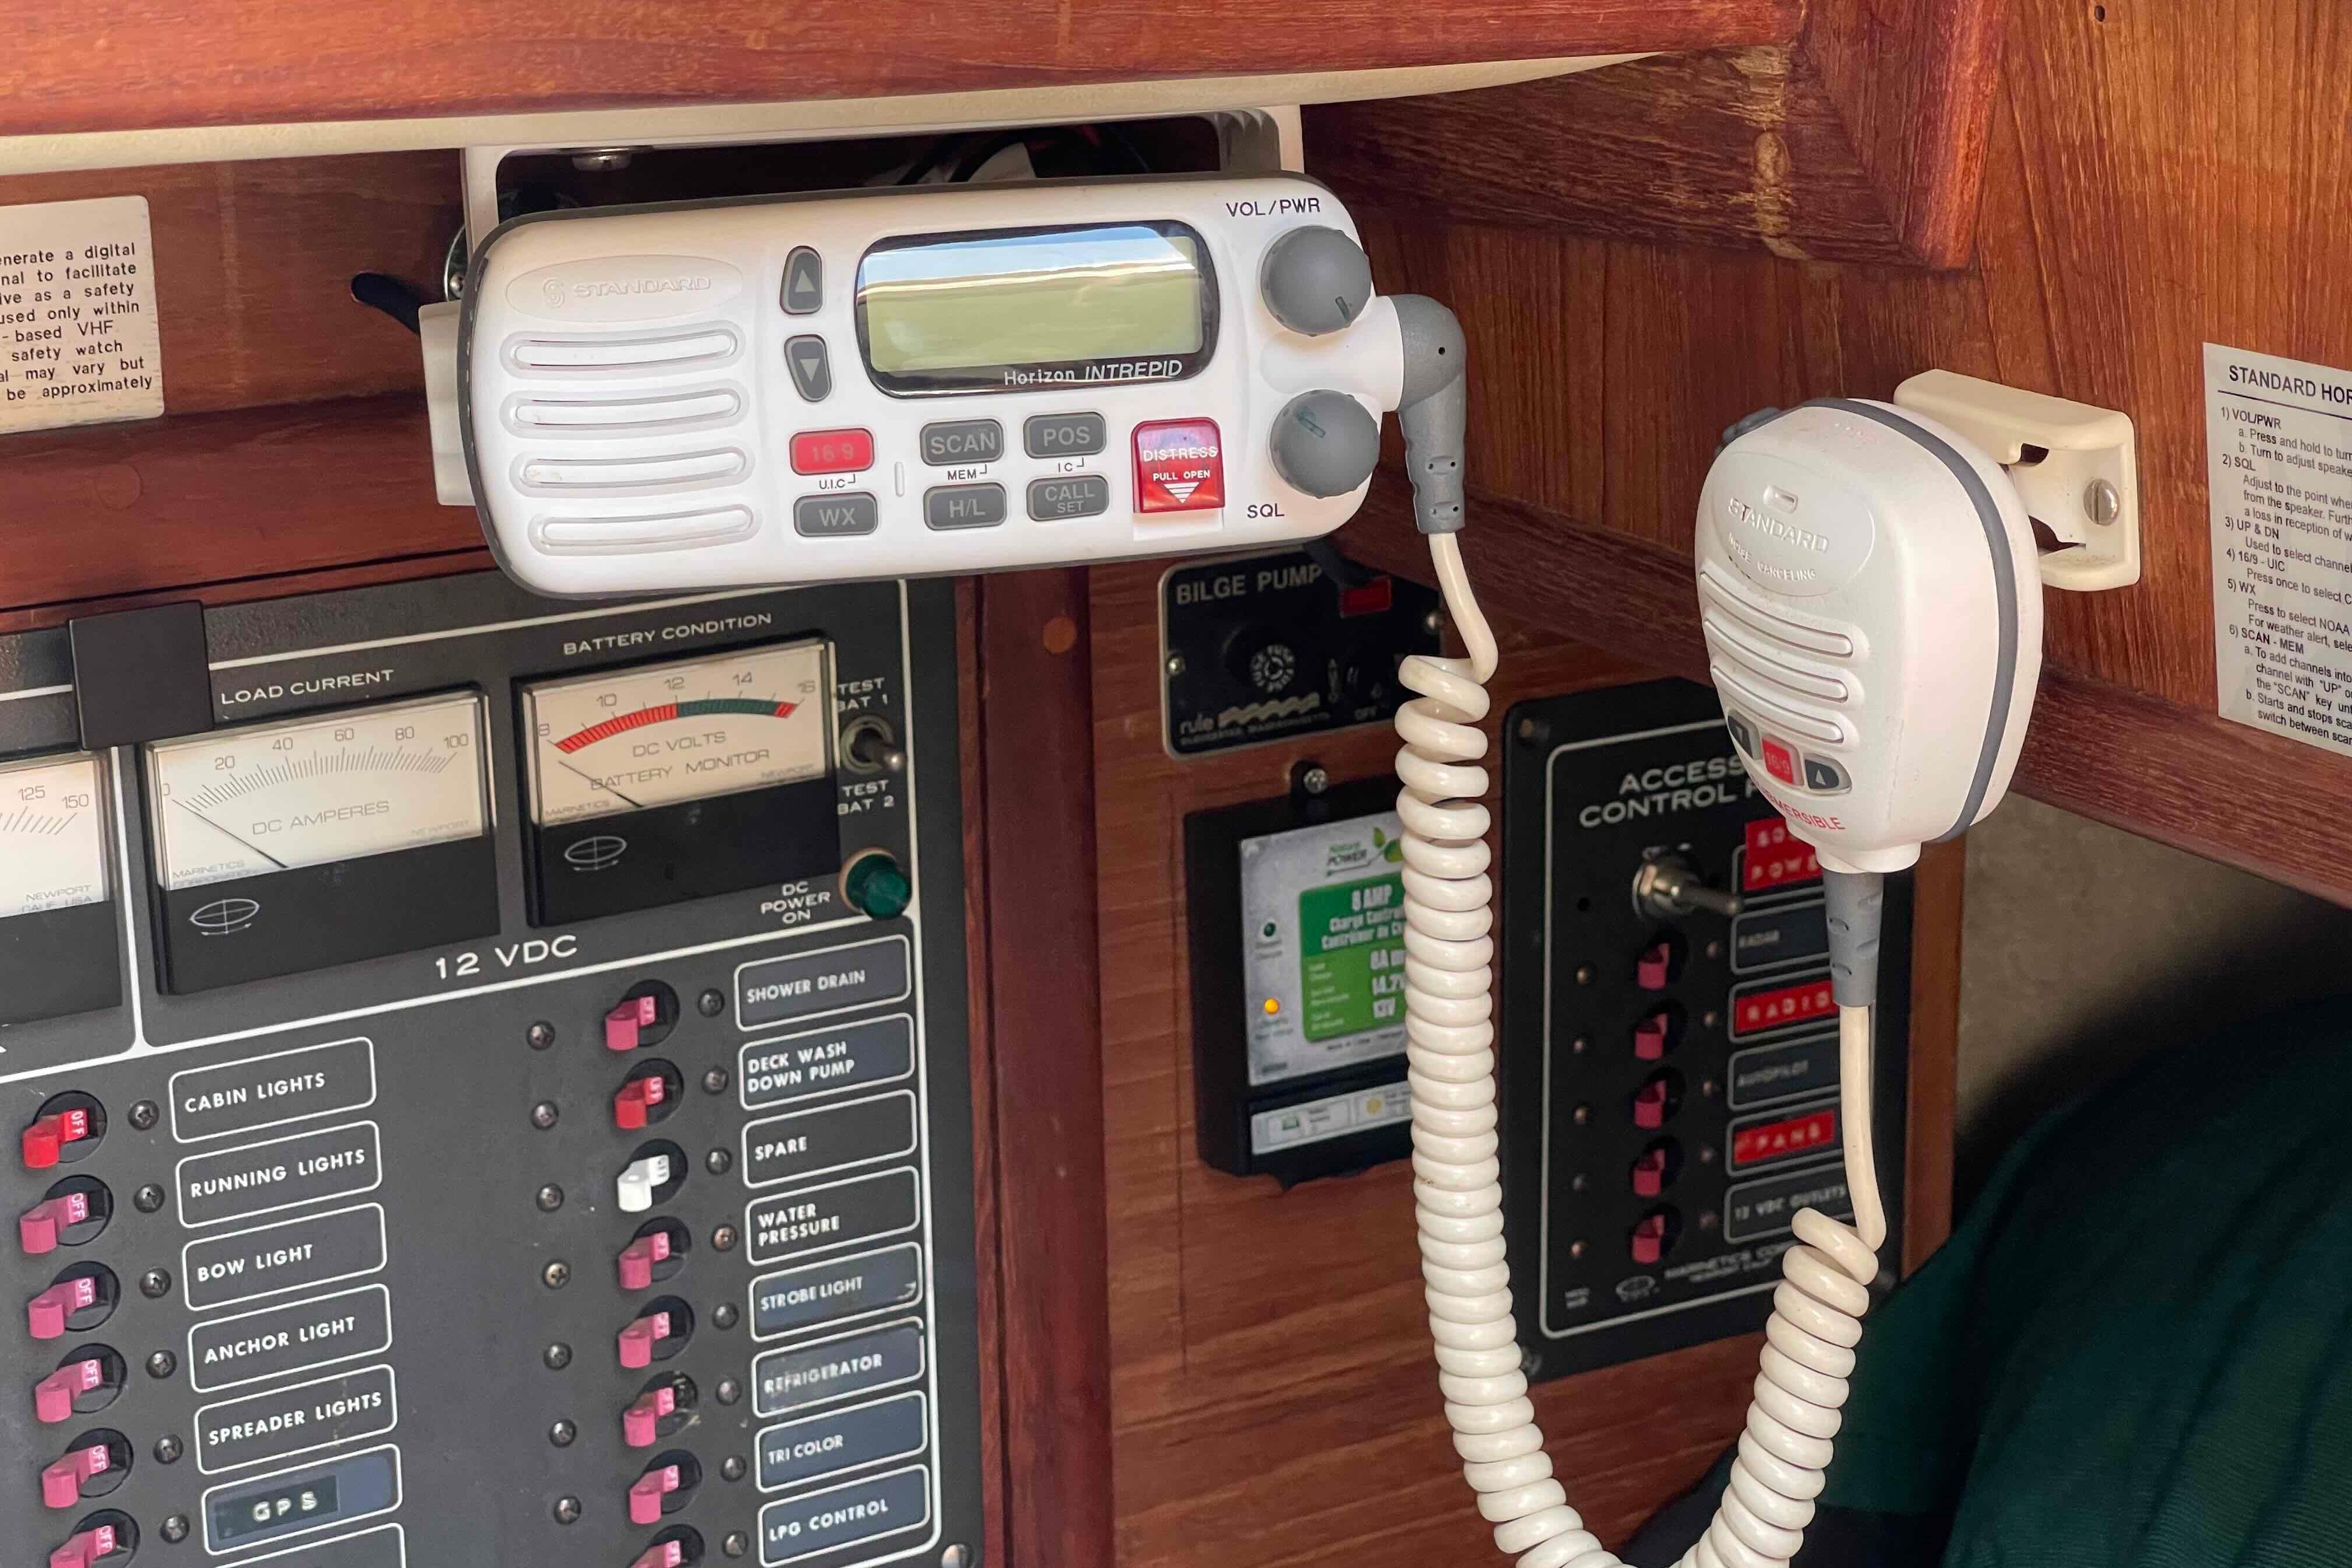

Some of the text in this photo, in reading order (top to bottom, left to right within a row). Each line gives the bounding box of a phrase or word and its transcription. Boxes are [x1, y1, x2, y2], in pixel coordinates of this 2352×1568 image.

[1225, 197, 1321, 218] VOL/PWR
[85, 242, 135, 260] digital
[37, 262, 137, 282] to facilitate
[34, 282, 134, 302] as safety
[573, 275, 712, 298] STANDARD
[47, 300, 139, 320] only within
[15, 320, 114, 342] based VHF
[11, 340, 123, 361] safety watch
[26, 356, 145, 381] may vary but
[1005, 359, 1183, 386] Horizon INTREPID
[2229, 365, 2316, 397] STANDARD
[6, 375, 153, 401] be approximately
[2232, 408, 2282, 430] VOL/PWR
[930, 431, 996, 456] SCAN
[1042, 426, 1091, 447] POS
[2250, 428, 2321, 454] Press and hold
[1142, 447, 1219, 462] DISTRESS
[2234, 456, 2256, 471] SQL
[2250, 444, 2316, 469] Turn adjust
[947, 468, 978, 480] MEM
[1152, 469, 1211, 481] PULL OPEN
[1045, 483, 1096, 502] CALL
[2243, 474, 2329, 505] Adjust the point
[2244, 490, 2282, 509] from the
[819, 508, 856, 527] WX
[949, 498, 986, 519] H/L
[1056, 501, 1085, 514] SET
[1247, 503, 1285, 520] SQL
[1728, 497, 1829, 554] STANDARD
[2253, 507, 2330, 537] loss reception
[2245, 536, 2312, 564] Used select
[1757, 561, 1817, 582] CANCELING
[2267, 556, 2286, 572] UIC
[1175, 563, 1323, 605] BILGE PUMP
[2239, 580, 2256, 596] WX
[2246, 567, 2342, 603] Press once select
[2248, 598, 2351, 636] Press select NOAA
[2248, 614, 2304, 638] For weather
[563, 612, 773, 656] BATTERY CONDITION
[2241, 627, 2305, 654] SCAN MEM
[2256, 663, 2314, 688] channel with
[2269, 652, 2332, 678] add channels
[221, 669, 395, 705] LOAD CURRENT
[664, 676, 685, 691] 12
[732, 671, 754, 686] 14
[837, 677, 885, 695] TEST
[596, 693, 618, 708] 10
[837, 696, 871, 713] BAT
[2257, 677, 2332, 710] the key
[2258, 692, 2333, 724] Starts and stops
[333, 727, 355, 743] 60
[394, 726, 415, 741] 80
[2258, 709, 2329, 739] switch between
[271, 737, 294, 752] 40
[443, 733, 470, 750] 100
[632, 731, 726, 758] DC VOLTS
[214, 755, 236, 771] 20
[590, 748, 770, 791] BATTERY MONITOR
[18, 785, 47, 802] 125
[842, 779, 890, 797] TEST
[61, 793, 90, 810] 150
[837, 796, 895, 816] BAT 2
[1578, 784, 1737, 828] CONTROL
[251, 800, 390, 836] DC AMPERES
[173, 860, 245, 878] MARINETICS
[1326, 849, 1367, 866] POWER
[25, 884, 92, 902] NEWPORT
[782, 881, 809, 897] DC
[1363, 884, 1392, 909] AMP
[760, 890, 831, 915] POWER
[782, 909, 811, 925] ON
[436, 935, 578, 979] 12 VDC
[747, 970, 866, 1003] SHOWER DRAIN
[1746, 991, 1831, 1021] RADIO
[747, 1041, 847, 1074] DECK WASH
[747, 1059, 855, 1093] DOWN PUMP
[184, 1072, 326, 1113] CABIN LIGHTS
[70, 1110, 85, 1136] OFF
[754, 1136, 807, 1161] SPARE
[191, 1149, 365, 1198] RUNNING LIGHTS
[71, 1192, 86, 1219] OFF
[758, 1203, 817, 1228] WATER
[758, 1215, 840, 1247] PRESSURE
[197, 1244, 313, 1282] BOW LIGHT
[78, 1278, 93, 1304] OFF
[760, 1276, 863, 1312] STROBE LIGHT
[204, 1316, 355, 1364] ANCHOR LIGHT
[83, 1359, 99, 1385] OFF
[764, 1353, 883, 1394] REFRIGERATOR
[208, 1392, 382, 1446] SPREADER LIGHTS
[92, 1444, 107, 1471] OFF
[768, 1434, 844, 1465] TRI COLOR
[253, 1490, 318, 1522] GPS
[769, 1498, 889, 1542] LPG CONTROL
[99, 1524, 113, 1550] OFF
